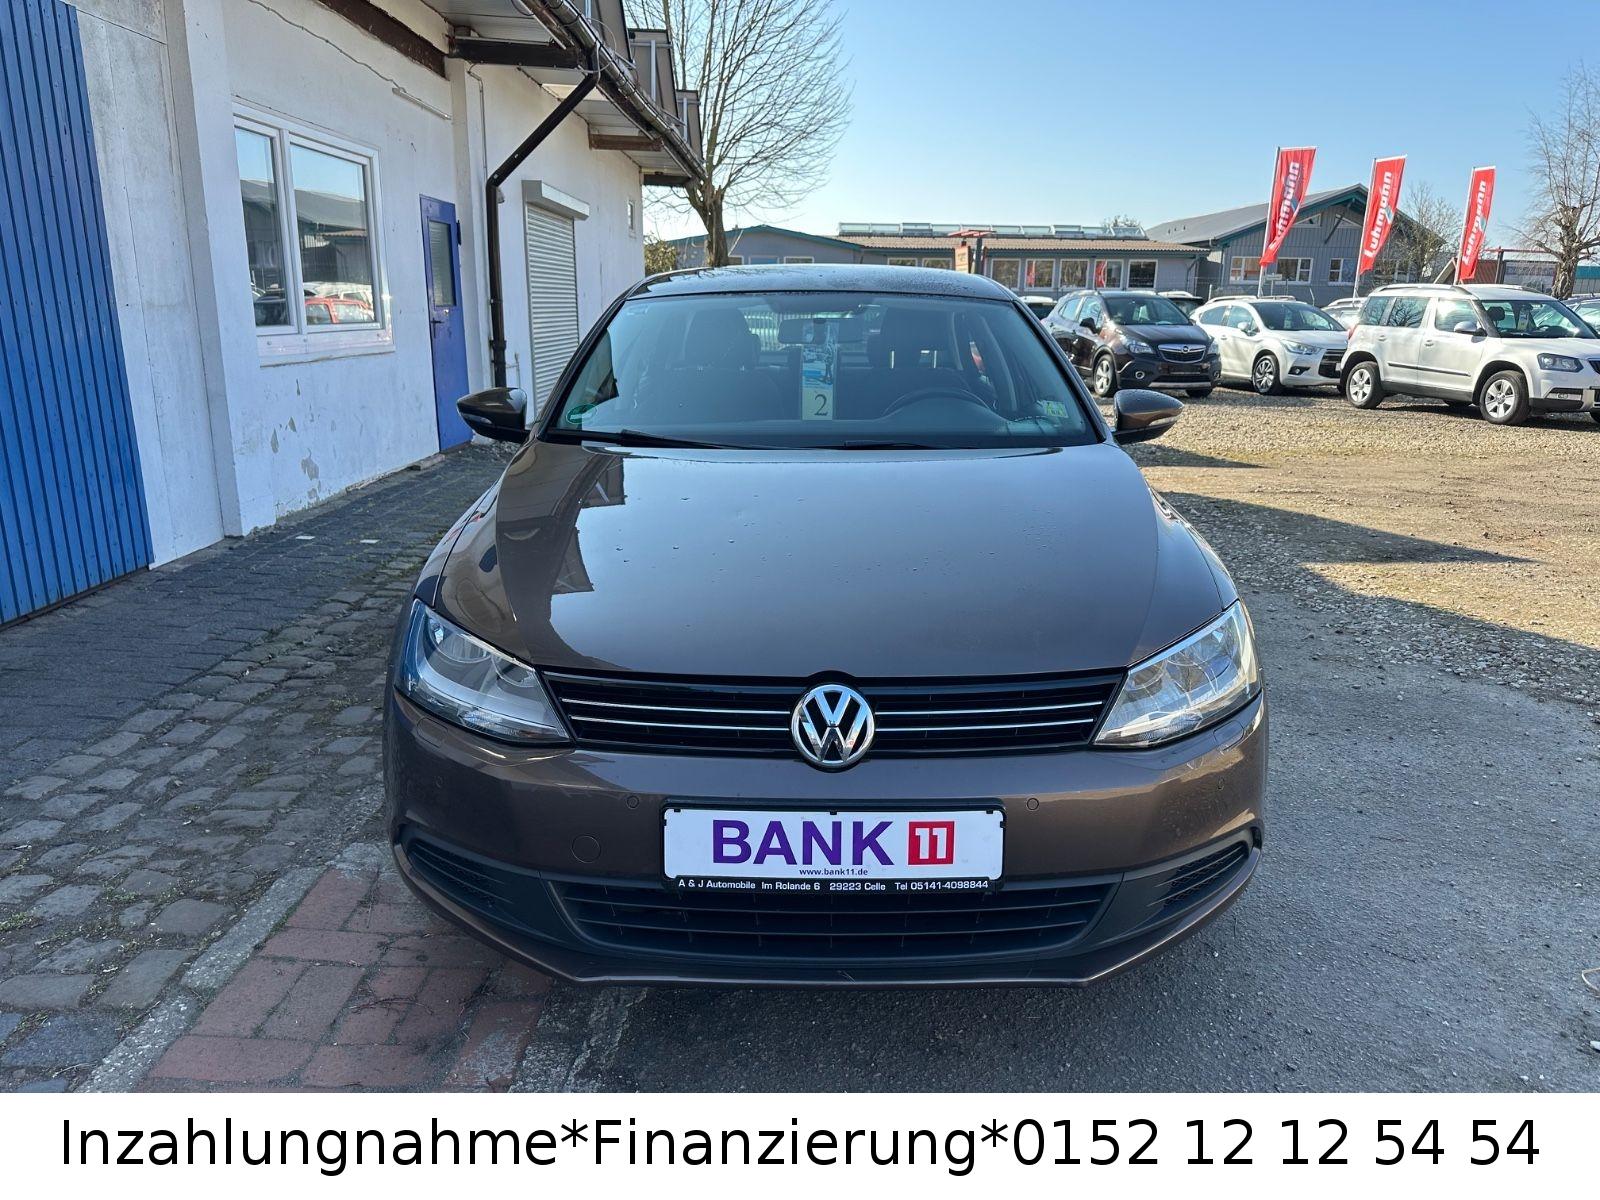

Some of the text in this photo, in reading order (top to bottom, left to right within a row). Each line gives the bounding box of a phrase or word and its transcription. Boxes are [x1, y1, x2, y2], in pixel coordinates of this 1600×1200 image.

[1363, 171, 1392, 258] Luhmann
[814, 394, 828, 416] 2
[712, 819, 948, 866] BANK 11
[799, 868, 868, 876] www.bank11.de
[678, 878, 686, 888] A
[688, 879, 696, 888] &
[698, 880, 704, 888] J
[706, 880, 756, 890] Automobile
[775, 882, 811, 891] Rolande
[813, 882, 821, 891] 6
[829, 882, 862, 891] 29223
[864, 882, 886, 891] Celle
[894, 882, 908, 890] Tel
[910, 880, 989, 890] 05141-4098844
